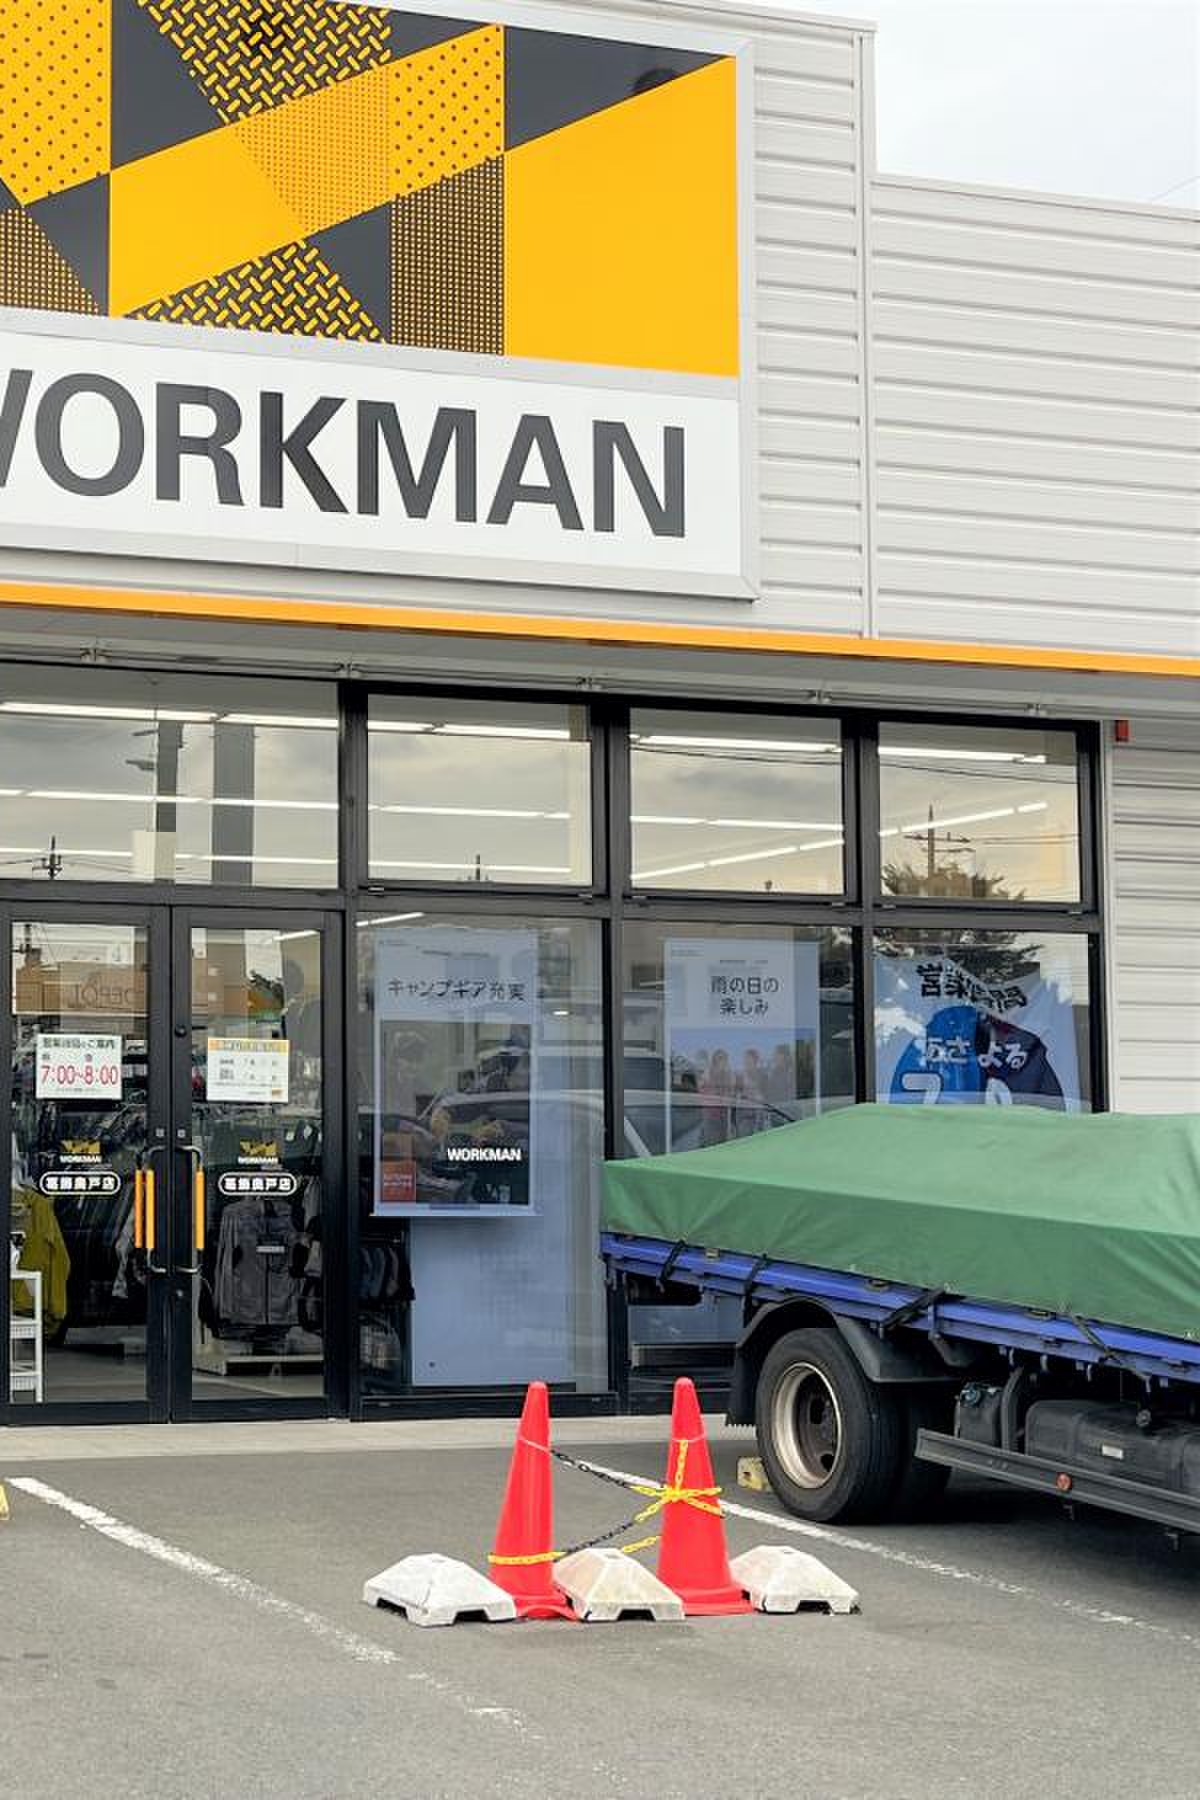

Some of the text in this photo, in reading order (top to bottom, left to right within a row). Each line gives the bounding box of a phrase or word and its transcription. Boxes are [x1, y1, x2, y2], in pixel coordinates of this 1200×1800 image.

[388, 978, 526, 1003] キャンプギア充実
[710, 975, 779, 994] 雨の日の
[719, 997, 769, 1016] 楽しみ
[978, 1040, 1028, 1070] よる
[447, 1146, 522, 1162] WORKMAN
